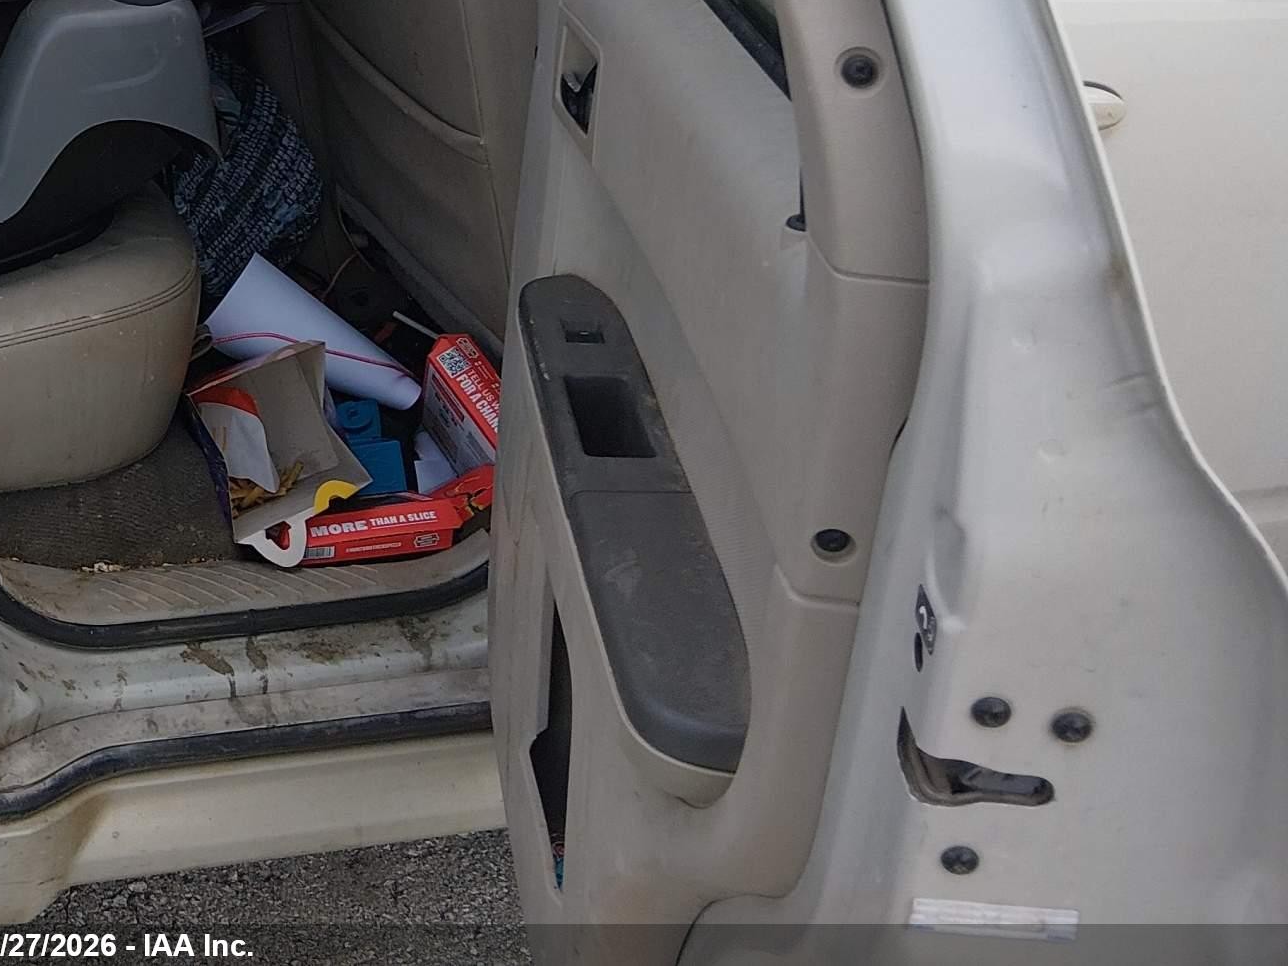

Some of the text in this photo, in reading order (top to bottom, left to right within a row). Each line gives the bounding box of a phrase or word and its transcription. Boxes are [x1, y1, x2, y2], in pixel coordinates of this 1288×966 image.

[467, 369, 485, 390] TELL
[482, 389, 495, 402] US
[456, 374, 477, 395] FOR
[470, 393, 480, 403] A
[476, 400, 499, 434] CHAN
[310, 511, 438, 538] MORE THAN A SLICE
